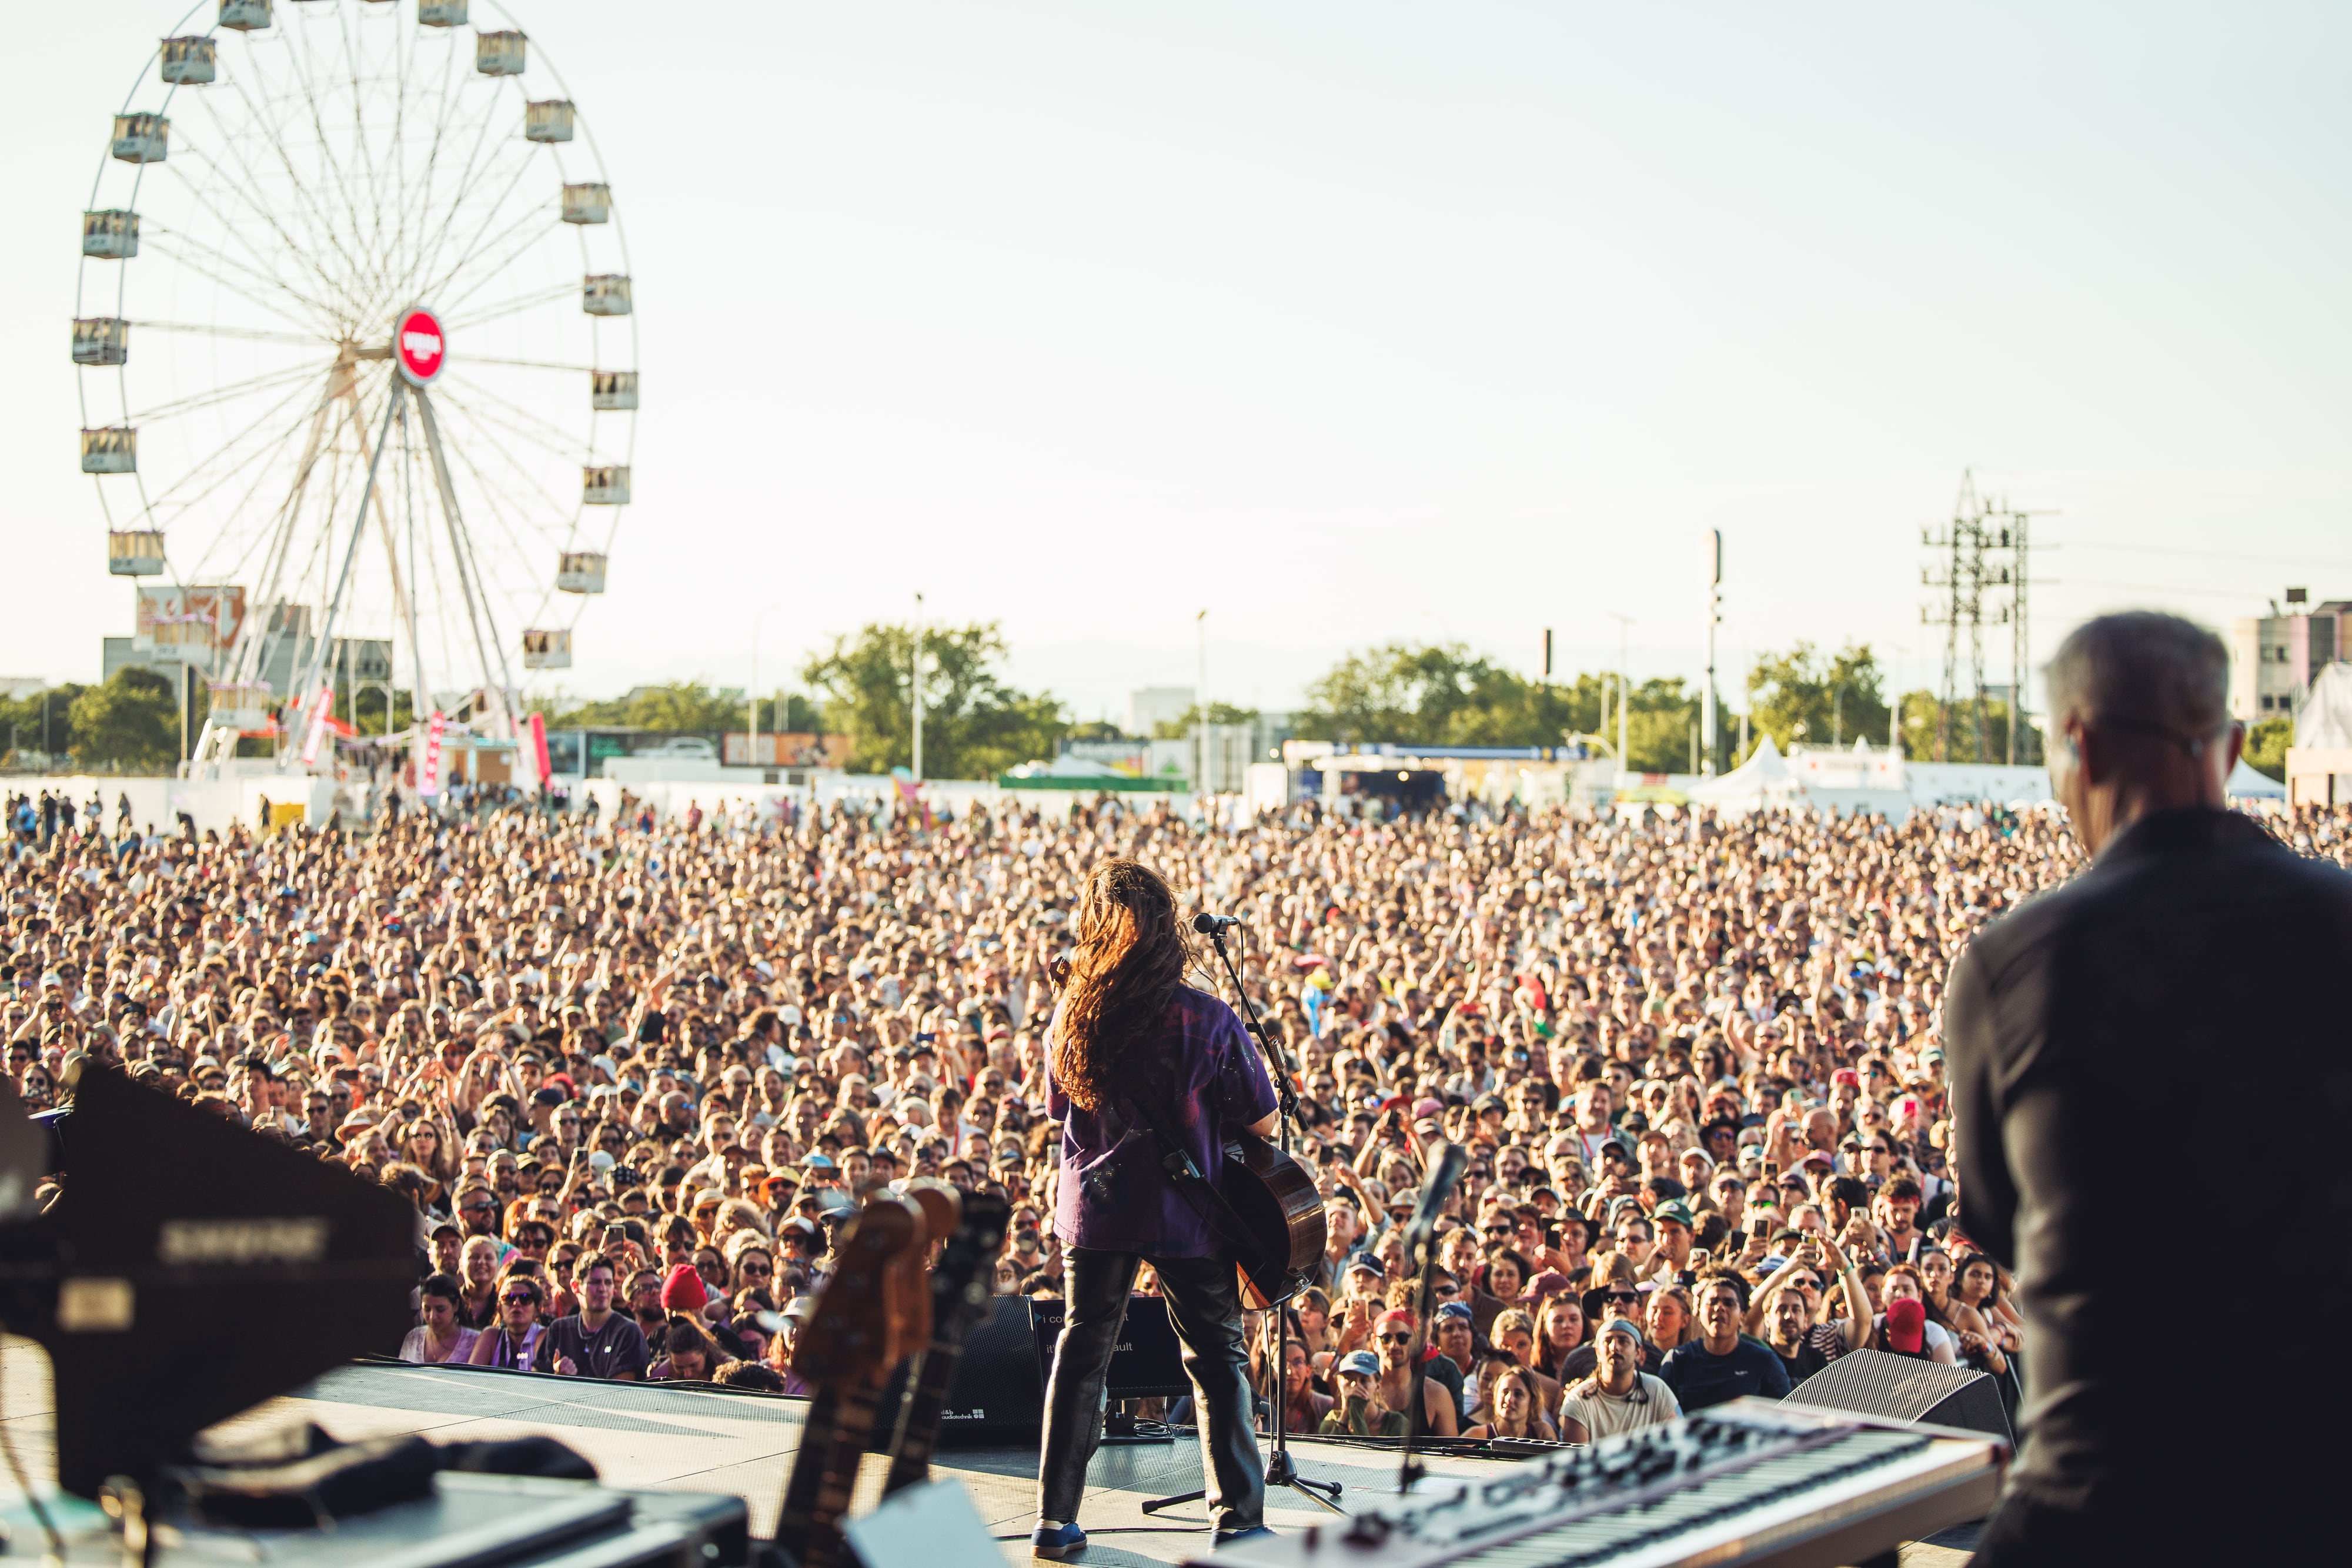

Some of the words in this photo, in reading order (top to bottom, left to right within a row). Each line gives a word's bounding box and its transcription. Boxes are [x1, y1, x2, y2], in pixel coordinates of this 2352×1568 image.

[1043, 1315, 1046, 1323] i
[1047, 1345, 1055, 1353] it'
[1113, 1342, 1132, 1352] ault
